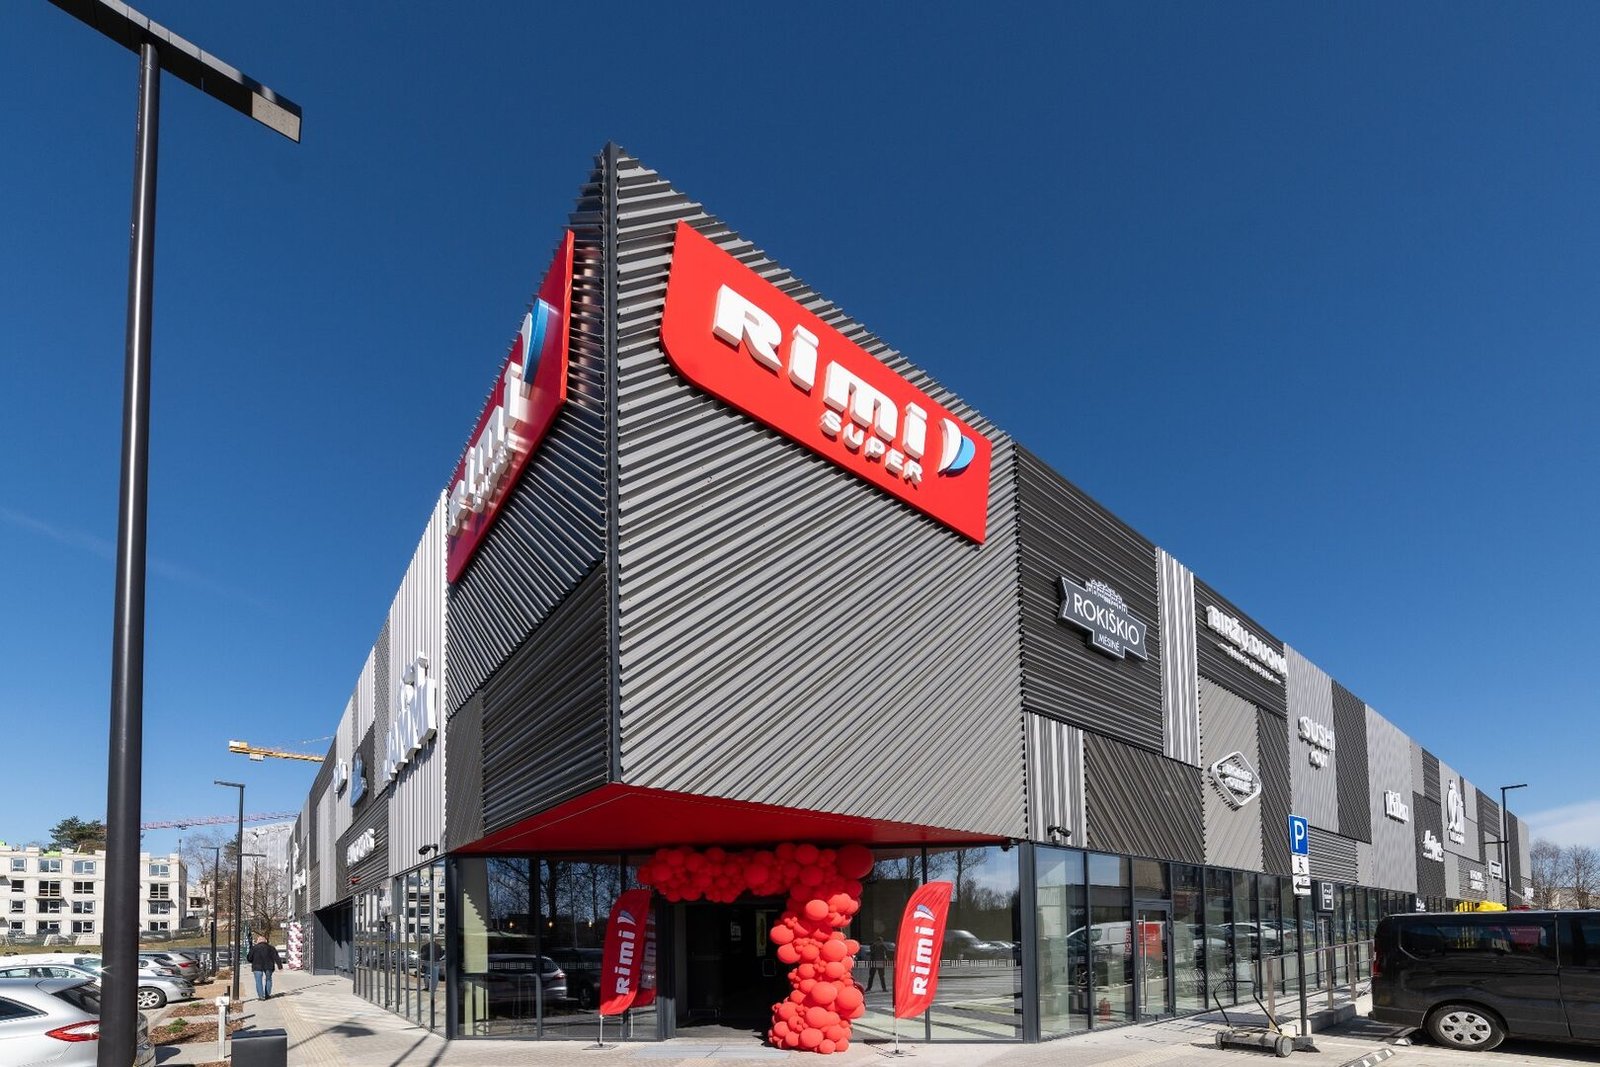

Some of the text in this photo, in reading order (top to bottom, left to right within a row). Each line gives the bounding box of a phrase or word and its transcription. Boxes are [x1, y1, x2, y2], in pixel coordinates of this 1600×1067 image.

[819, 409, 923, 484] SUPER
[1073, 592, 1140, 645] ROKIŠKIO
[1299, 716, 1336, 752] SUSHI
[1293, 820, 1305, 850] P
